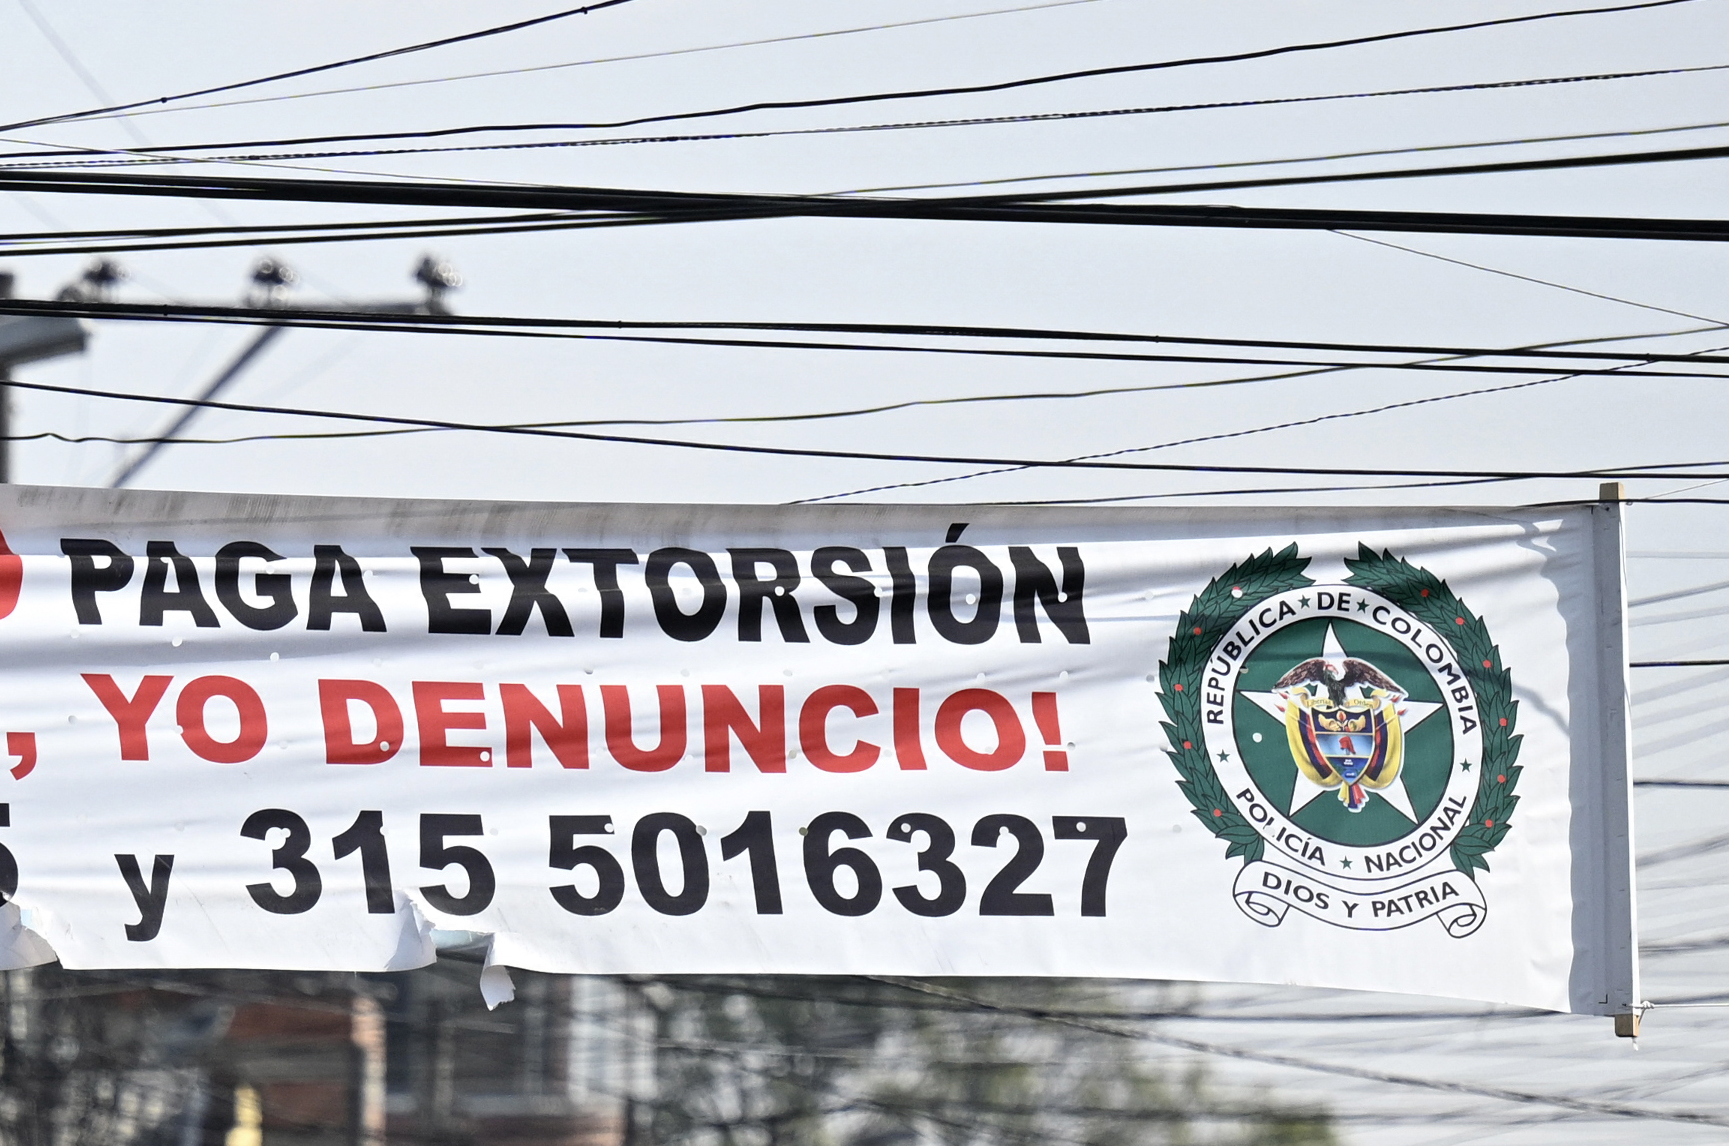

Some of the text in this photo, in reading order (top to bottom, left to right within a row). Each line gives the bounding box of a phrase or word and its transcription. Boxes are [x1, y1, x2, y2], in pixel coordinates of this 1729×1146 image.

[59, 537, 387, 633] PAGA
[409, 522, 1091, 646] EXTORSIÓN
[1206, 591, 1478, 735] REPÚBLICA DE COLOMBIA
[81, 673, 268, 764] YO
[318, 679, 1070, 773] DENUNCIO!
[114, 854, 175, 942] y
[240, 808, 496, 916] 315
[549, 810, 1128, 918] 5016327
[1363, 795, 1468, 874] NACIONAL
[1261, 871, 1460, 919] DIOS Y PATRIA
